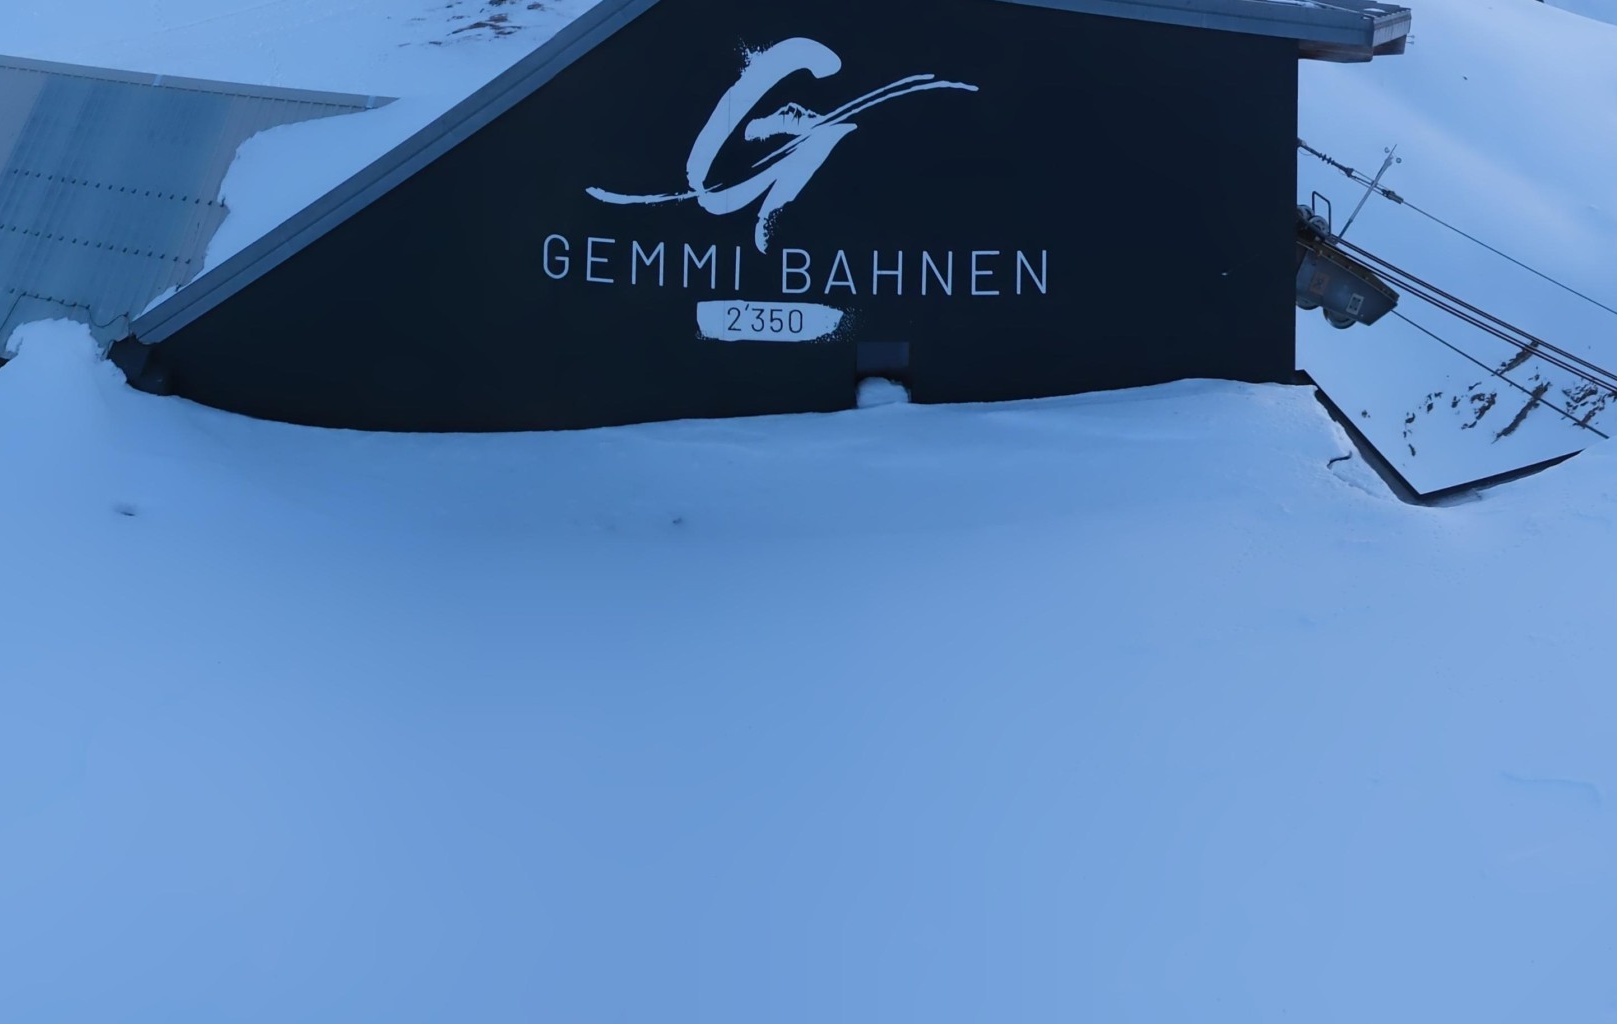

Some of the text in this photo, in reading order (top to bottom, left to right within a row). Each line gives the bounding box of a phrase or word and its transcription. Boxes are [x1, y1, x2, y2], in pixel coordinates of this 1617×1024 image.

[543, 233, 1047, 296] GEMMI BAHNEN
[727, 303, 804, 334] 2'350
